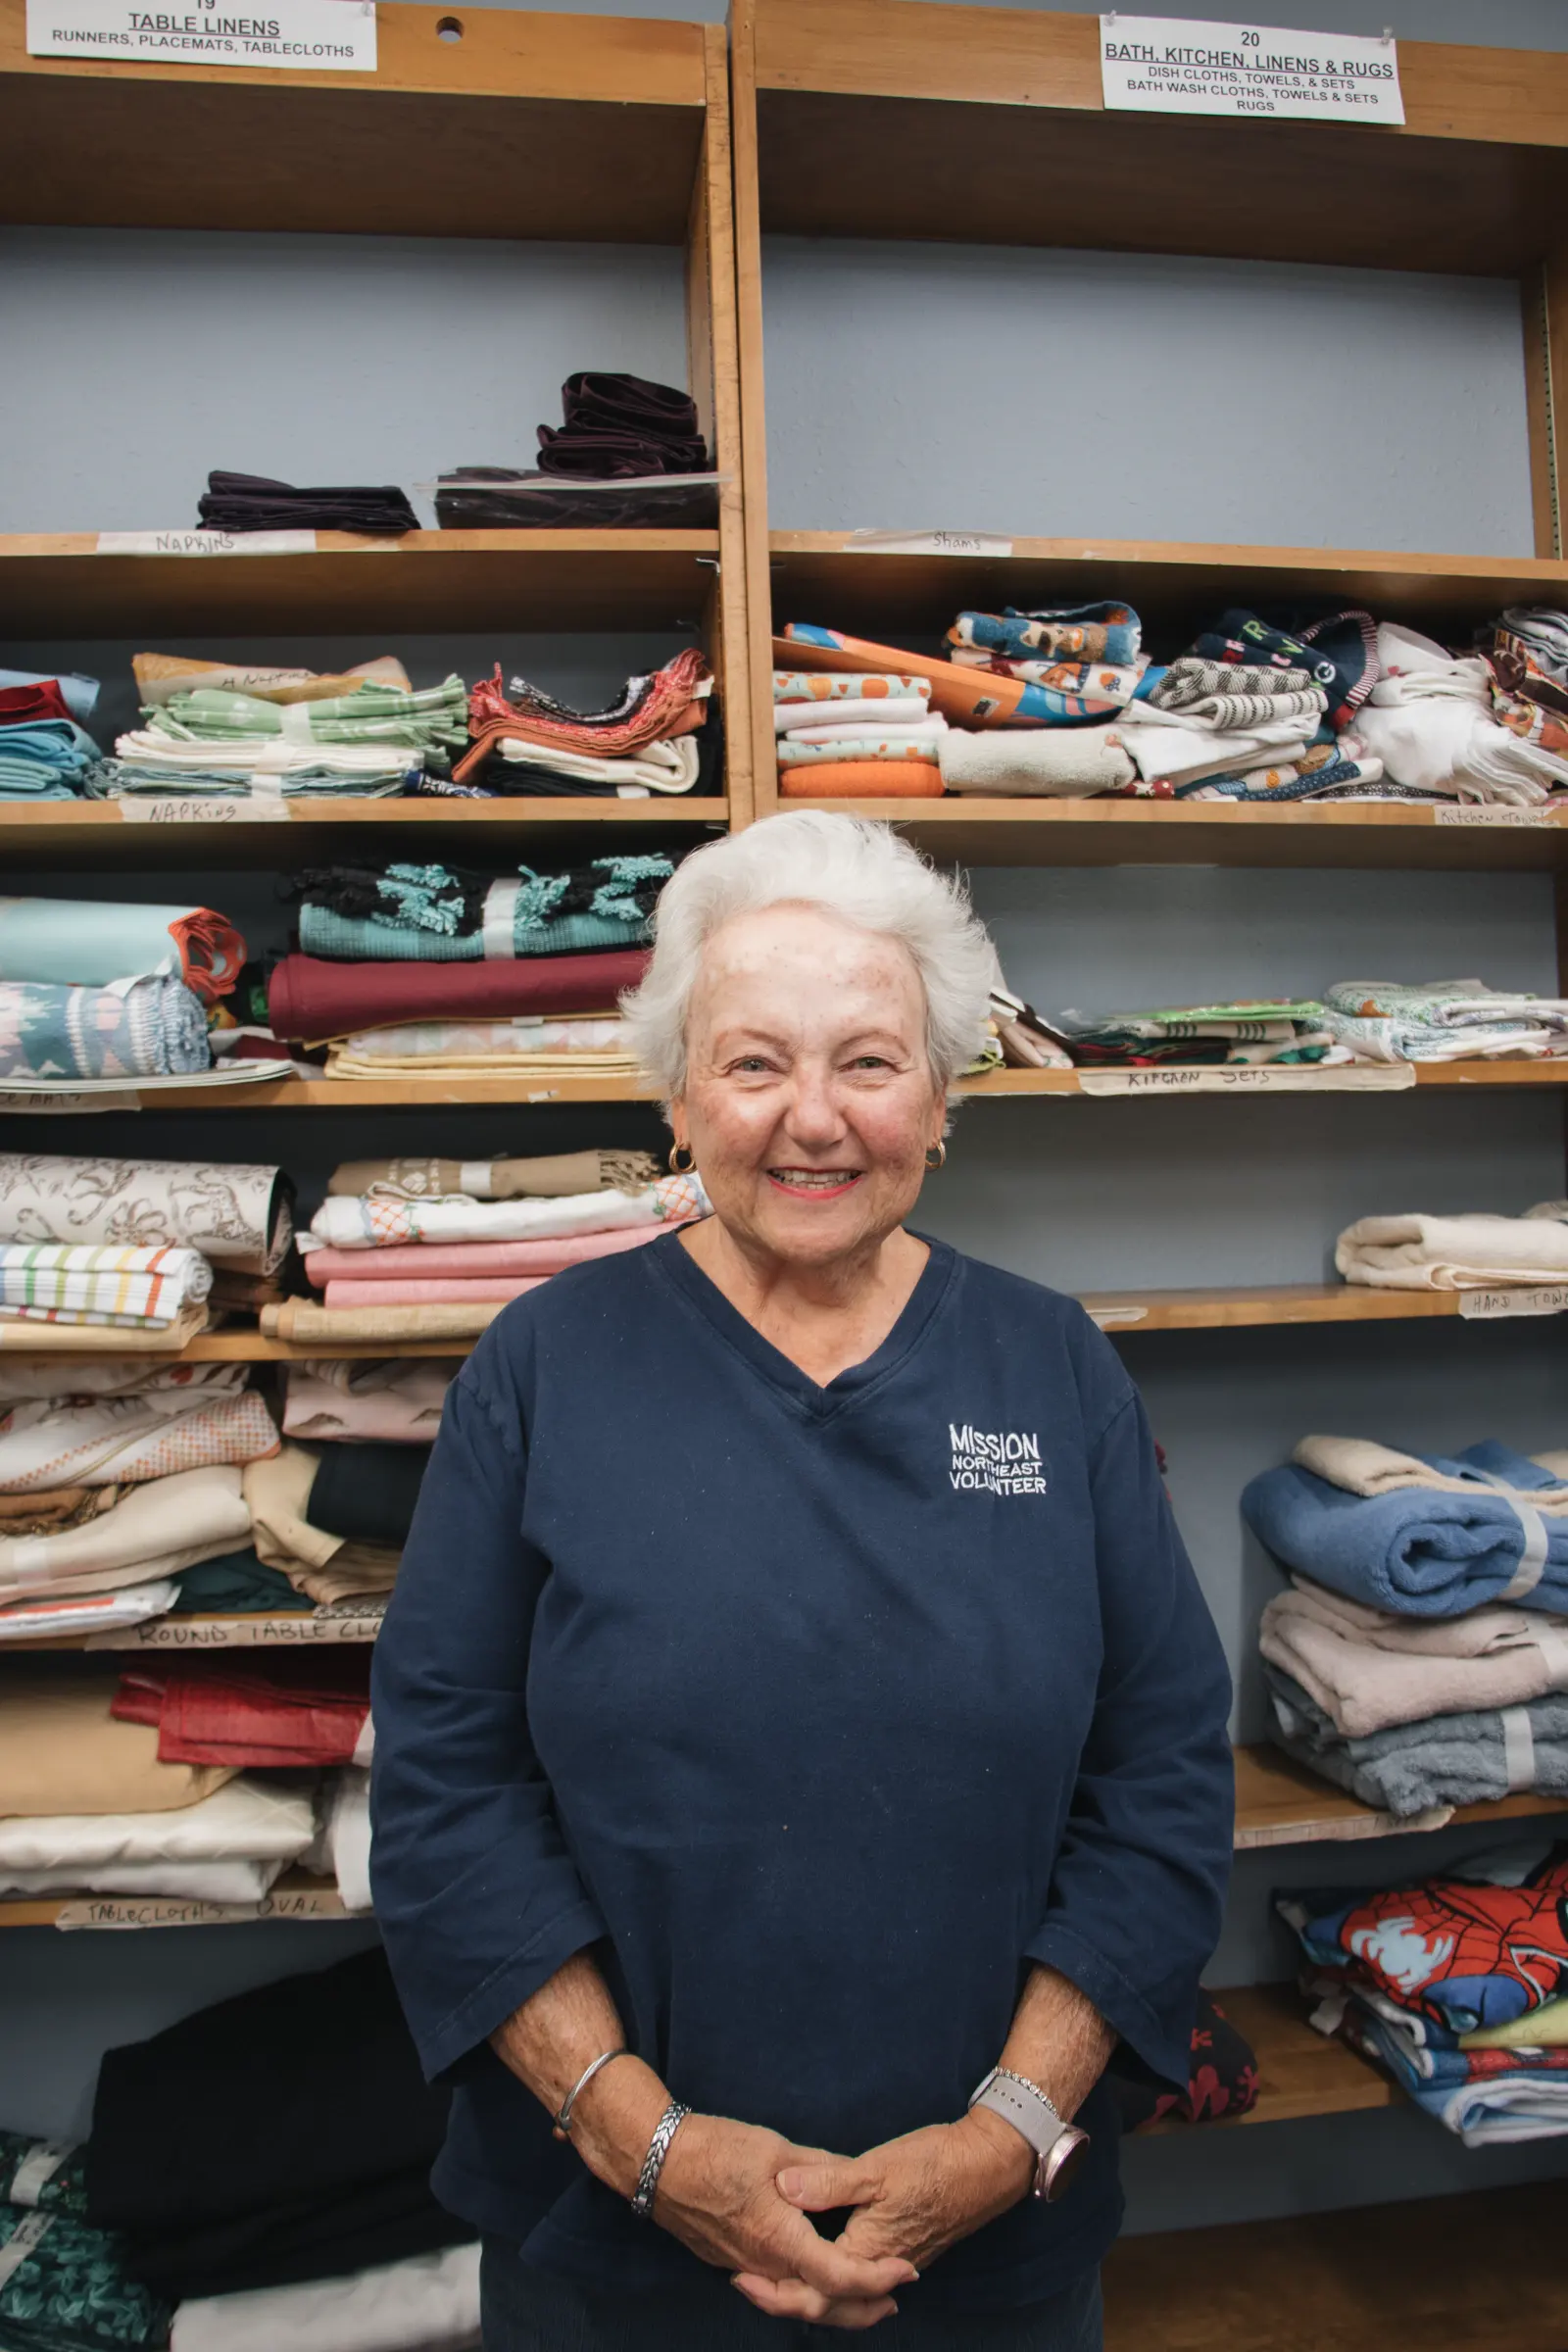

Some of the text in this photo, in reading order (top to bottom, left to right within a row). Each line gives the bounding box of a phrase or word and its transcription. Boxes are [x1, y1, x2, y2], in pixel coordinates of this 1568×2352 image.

[128, 13, 280, 36] TABLE LINENS
[52, 29, 355, 58] RUNNERS, PLACEMATS, TABLECLOTHS
[1241, 31, 1260, 47] 20
[1105, 43, 1394, 78] BATH, KITCHEN, LINENS & RUGS
[1149, 66, 1355, 90] DISH CLOTHS, TOWELS, & SETS
[1127, 79, 1379, 105] BATH WASH CLOTHS, TOWELS & SETS
[1237, 100, 1275, 112] RUGS
[156, 532, 234, 554] NAPKINS
[934, 533, 981, 551] Shams
[1474, 1294, 1510, 1314] HAND
[949, 1423, 1041, 1463] MISSION
[952, 1454, 1044, 1478] NORTHEAST
[949, 1471, 1047, 1496] VOLUNTEER
[138, 1625, 228, 1646] ROUND
[238, 1621, 327, 1641] TABLE
[257, 1898, 324, 1918] OVAL
